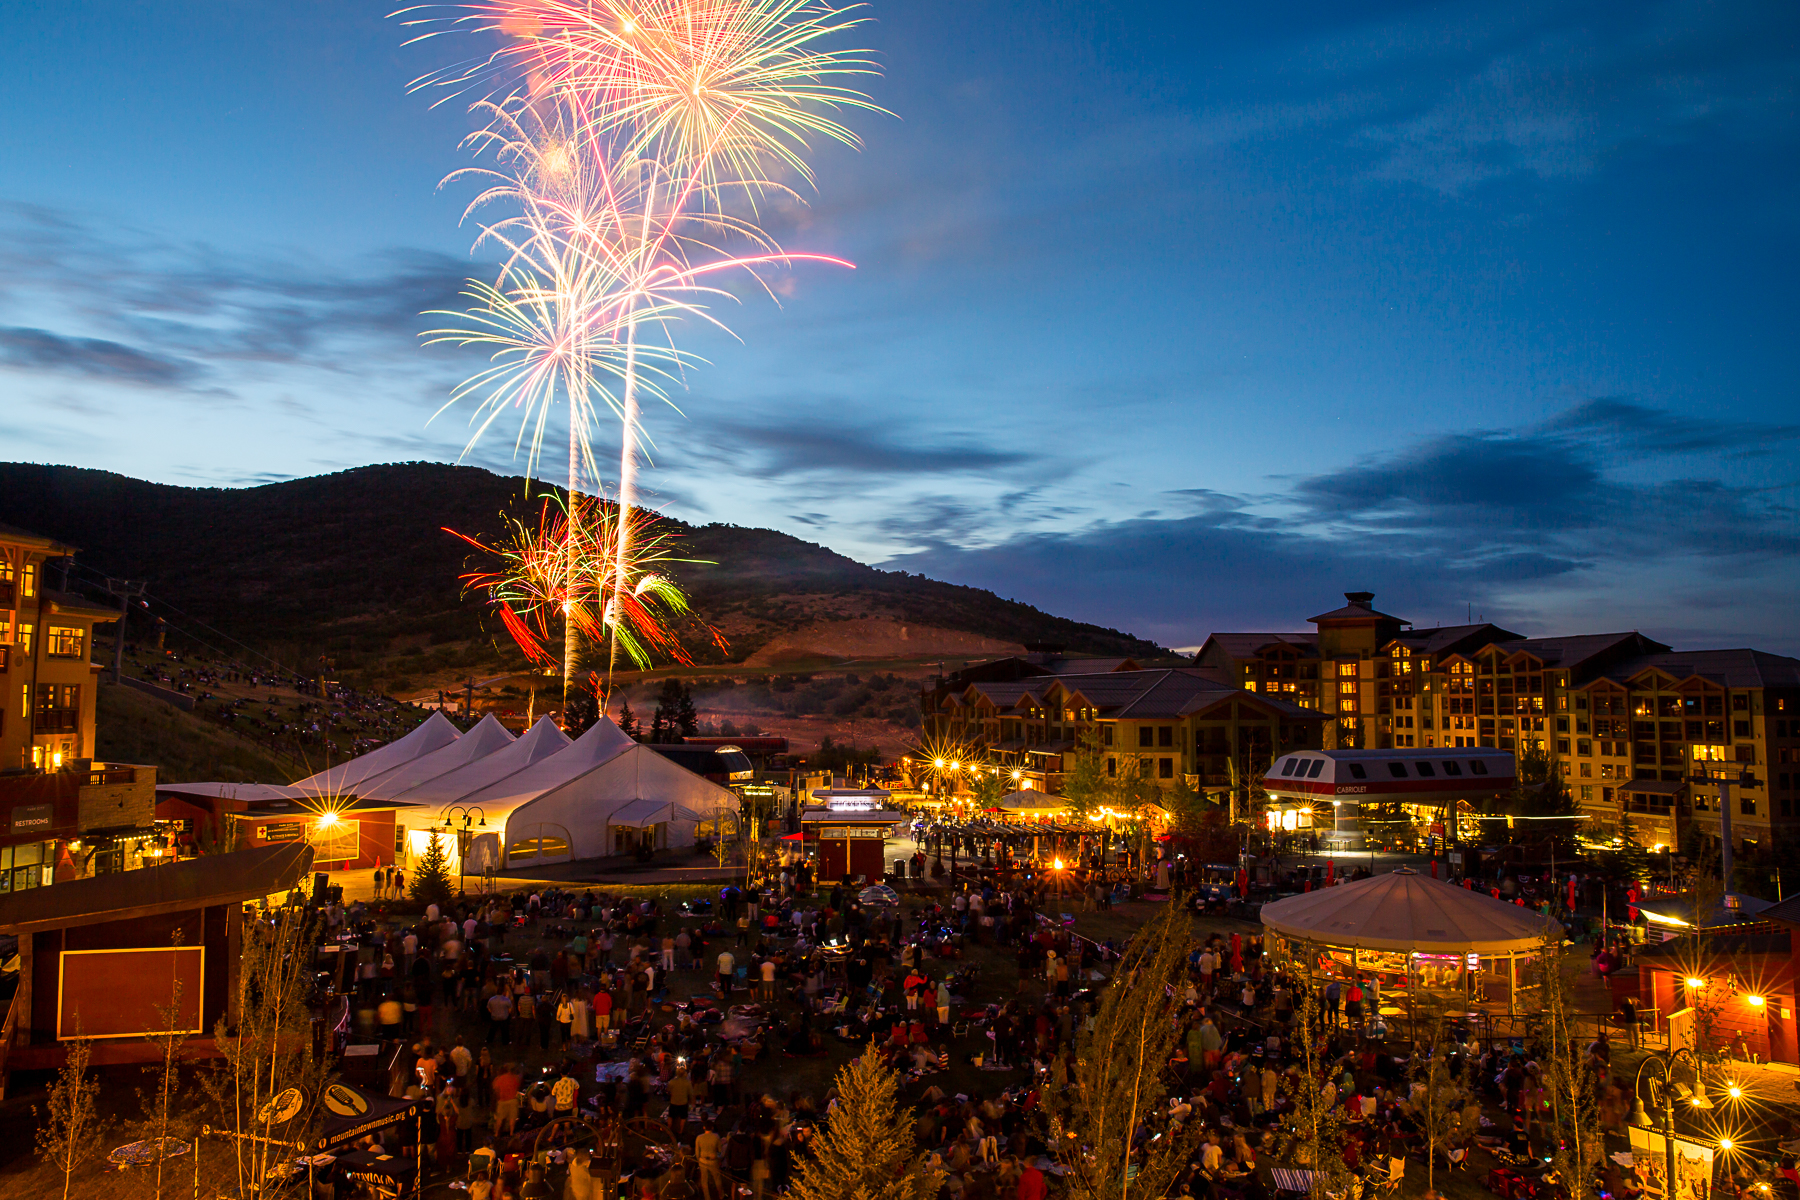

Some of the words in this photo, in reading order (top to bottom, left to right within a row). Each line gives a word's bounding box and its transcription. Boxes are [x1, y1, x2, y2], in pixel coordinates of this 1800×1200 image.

[1336, 785, 1367, 794] CABRIOLET
[14, 818, 49, 827] RESTROOMS
[330, 1110, 406, 1144] mountaintownmusic.org
